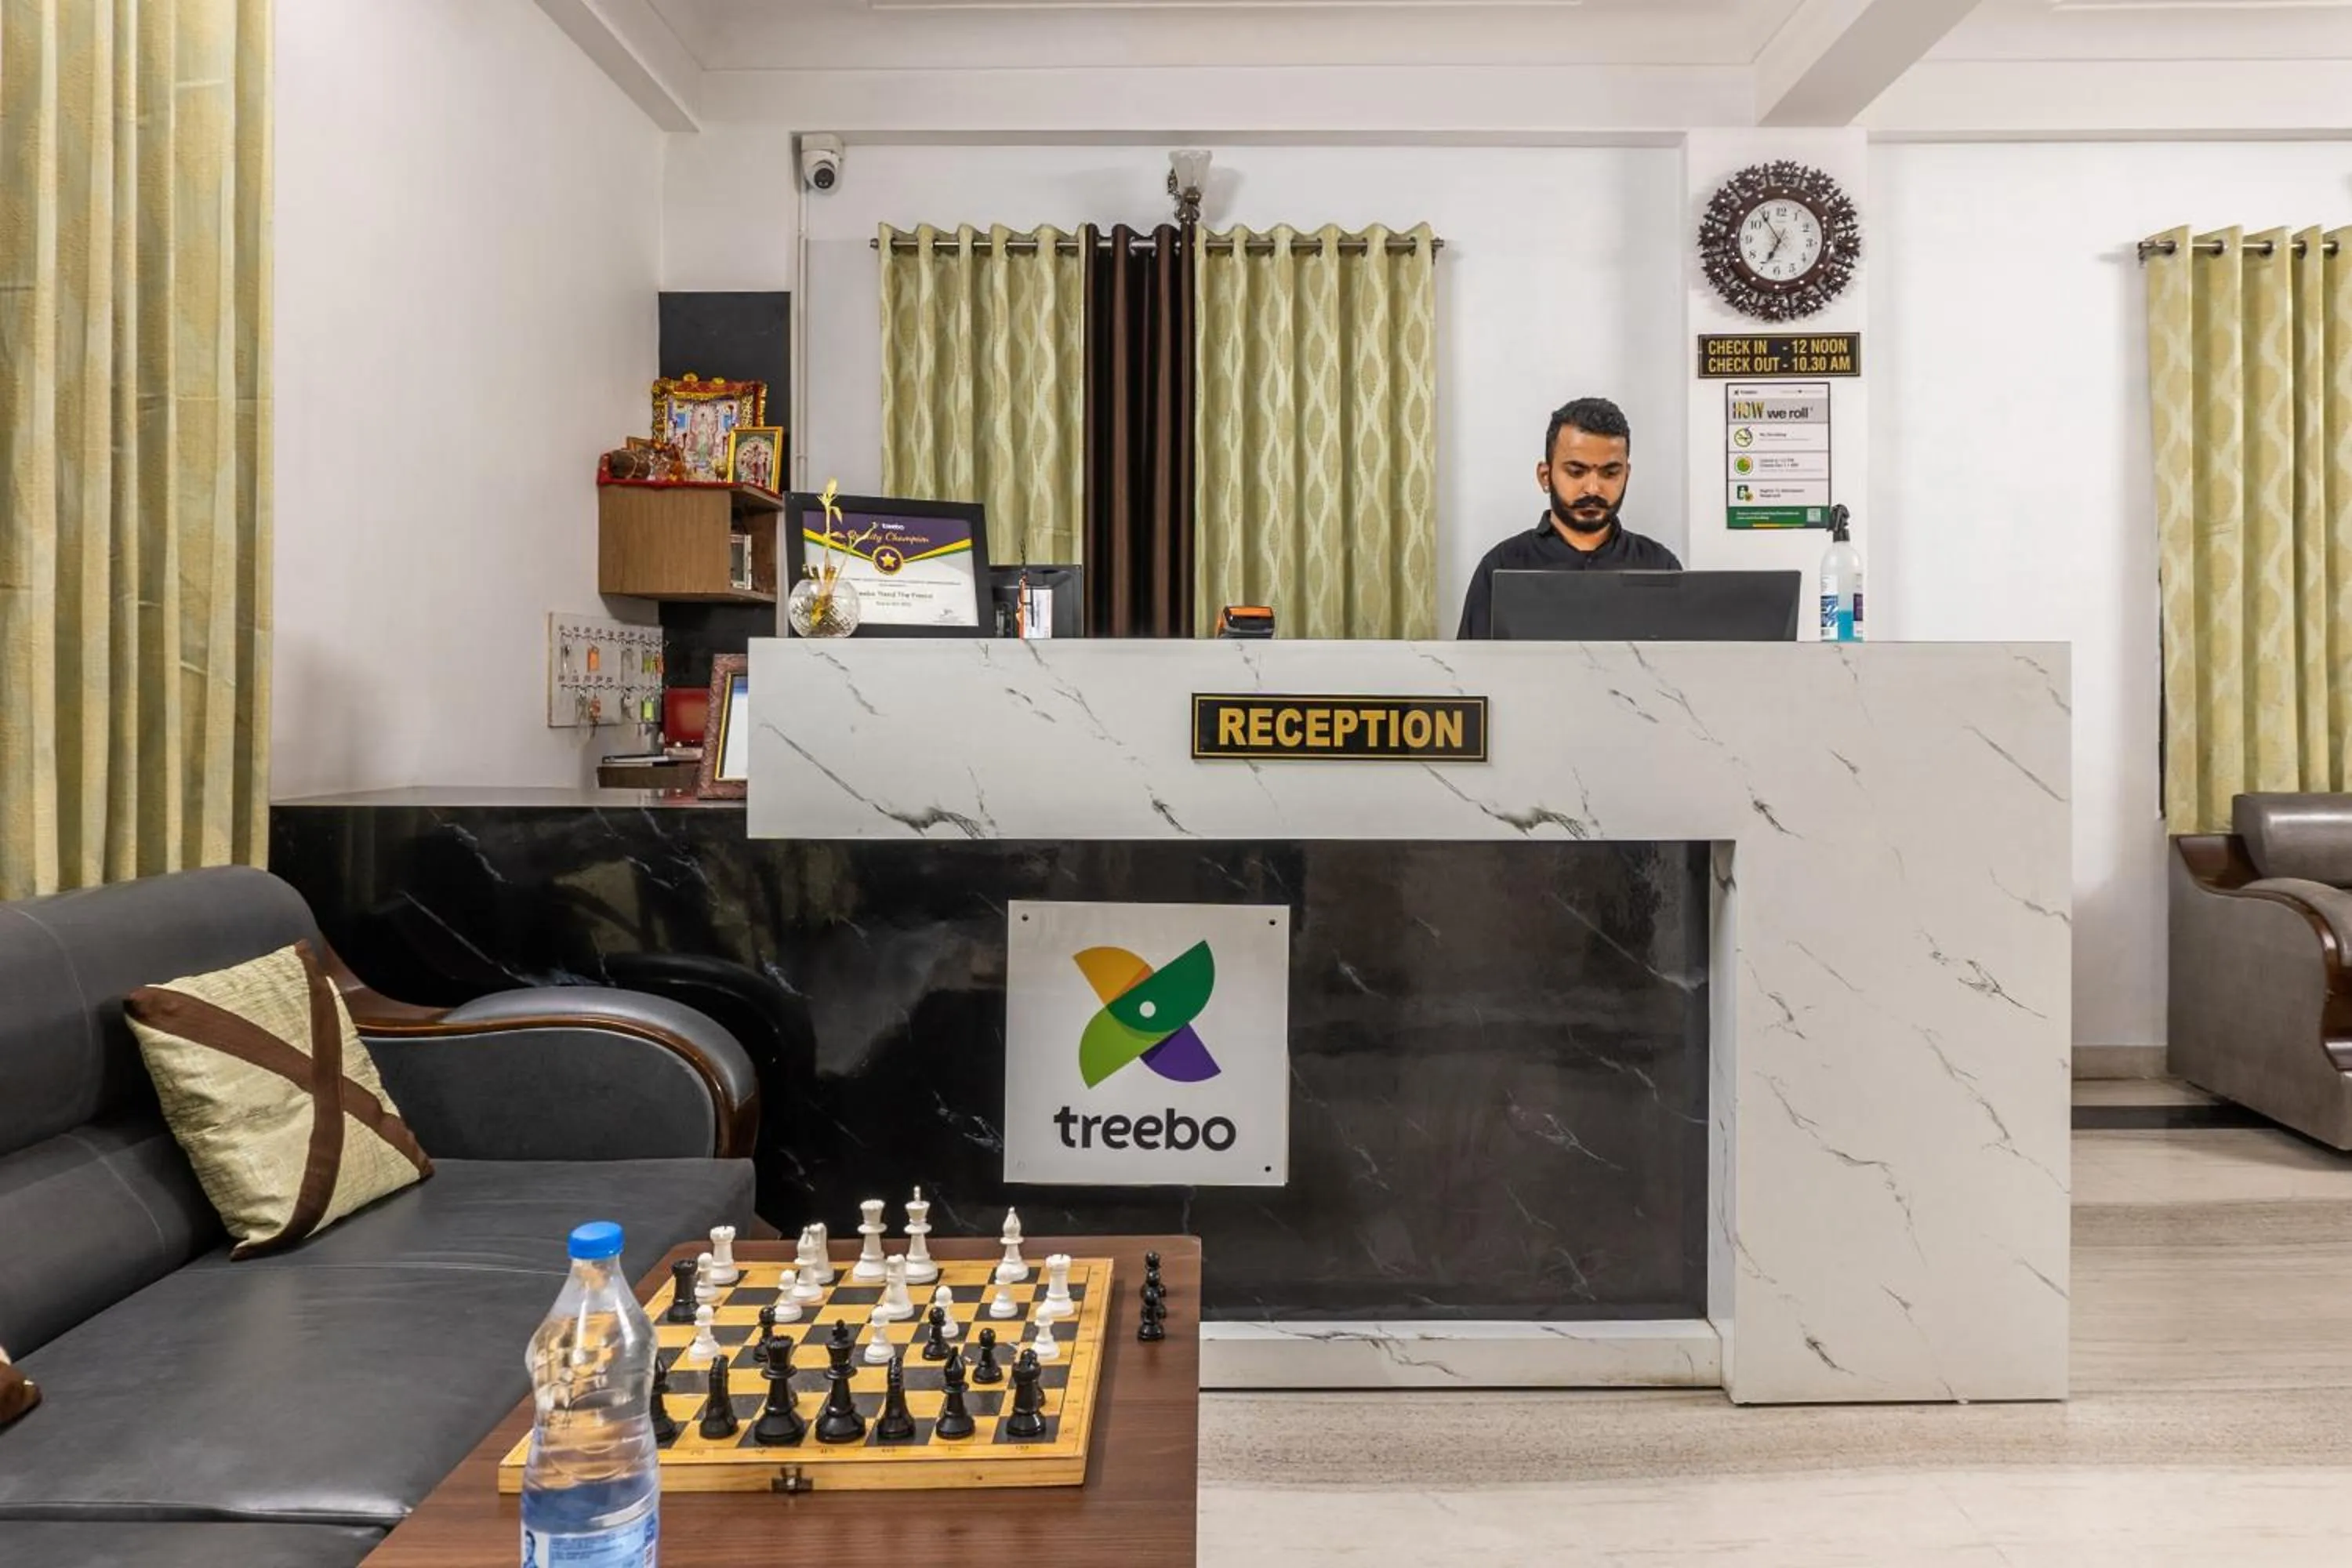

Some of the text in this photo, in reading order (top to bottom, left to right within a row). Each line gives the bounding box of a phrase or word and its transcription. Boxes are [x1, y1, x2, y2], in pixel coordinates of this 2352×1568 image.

[1776, 207, 1787, 217] 12
[1751, 220, 1762, 230] 10
[1708, 339, 1751, 355] CHECK
[1754, 339, 1768, 354] IN
[1791, 339, 1807, 354] 12
[1811, 338, 1848, 354] NOON
[1708, 358, 1751, 373] CHECK
[1754, 357, 1780, 372] OUT
[1791, 356, 1827, 372] 10.30
[1830, 356, 1851, 372] AM
[1733, 401, 1809, 419] HOW we roll
[1218, 707, 1463, 748] RECEPTION
[1054, 1105, 1236, 1152] treebo
